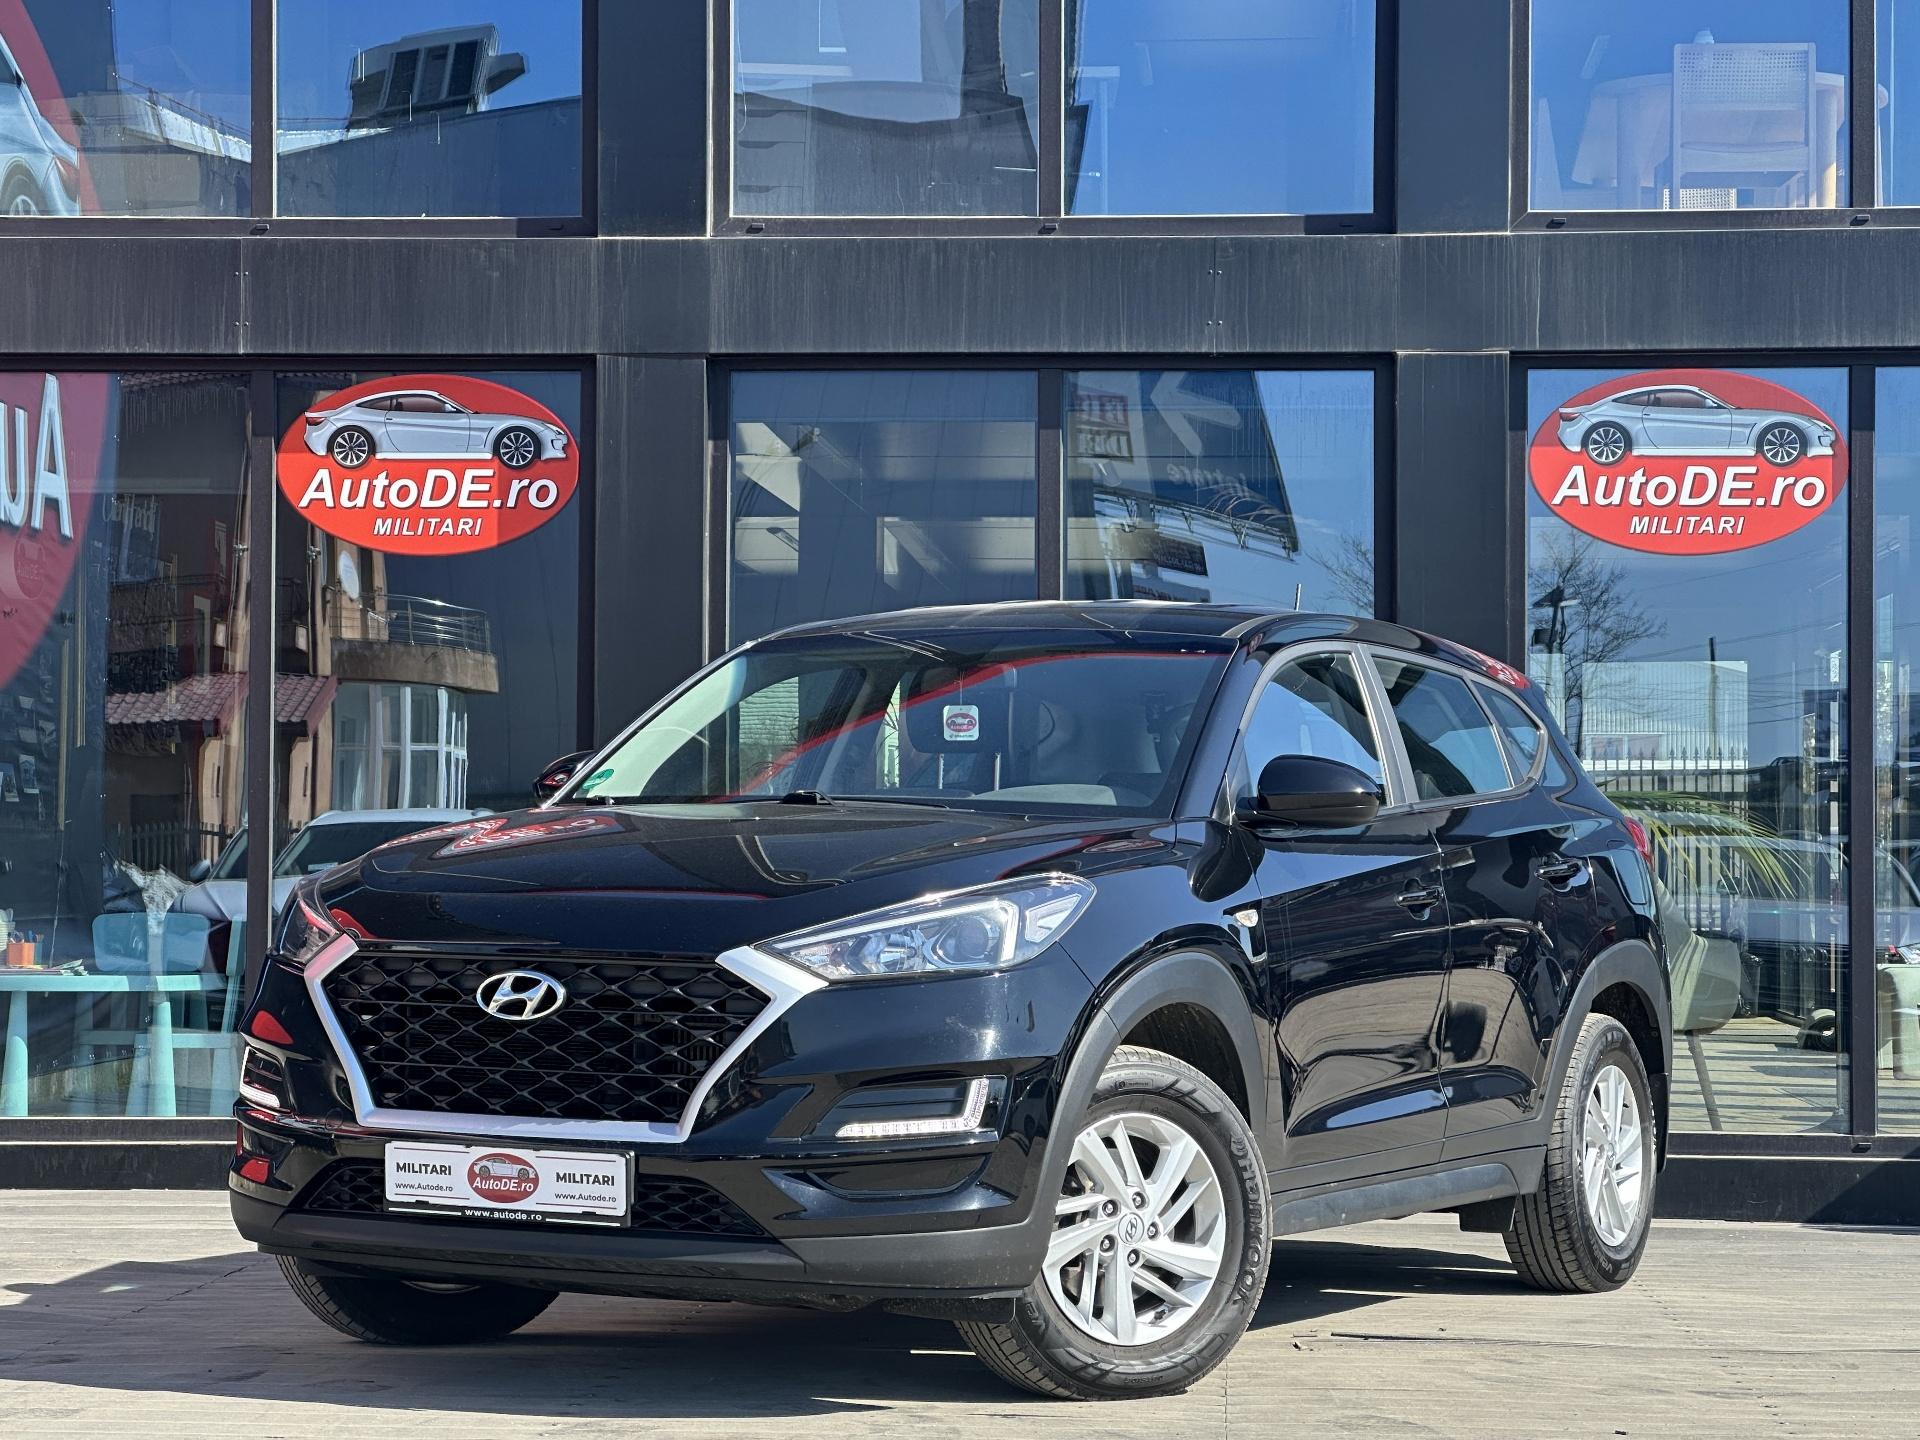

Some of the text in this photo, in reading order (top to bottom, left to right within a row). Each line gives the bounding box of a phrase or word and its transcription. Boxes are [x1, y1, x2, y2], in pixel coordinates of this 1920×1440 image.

[298, 469, 558, 509] AutoDE.ro
[1551, 465, 1826, 508] AutoDE.ro
[373, 517, 482, 536] MILITARI
[1629, 516, 1745, 535] MILITARI
[396, 1162, 452, 1176] MILITARI
[395, 1182, 454, 1192] www.Autode.ro
[472, 1177, 534, 1193] AutoDE.ro
[555, 1172, 615, 1187] MILITARI
[554, 1192, 617, 1203] www.Autode.ro
[464, 1208, 543, 1221] www.autode.ro
